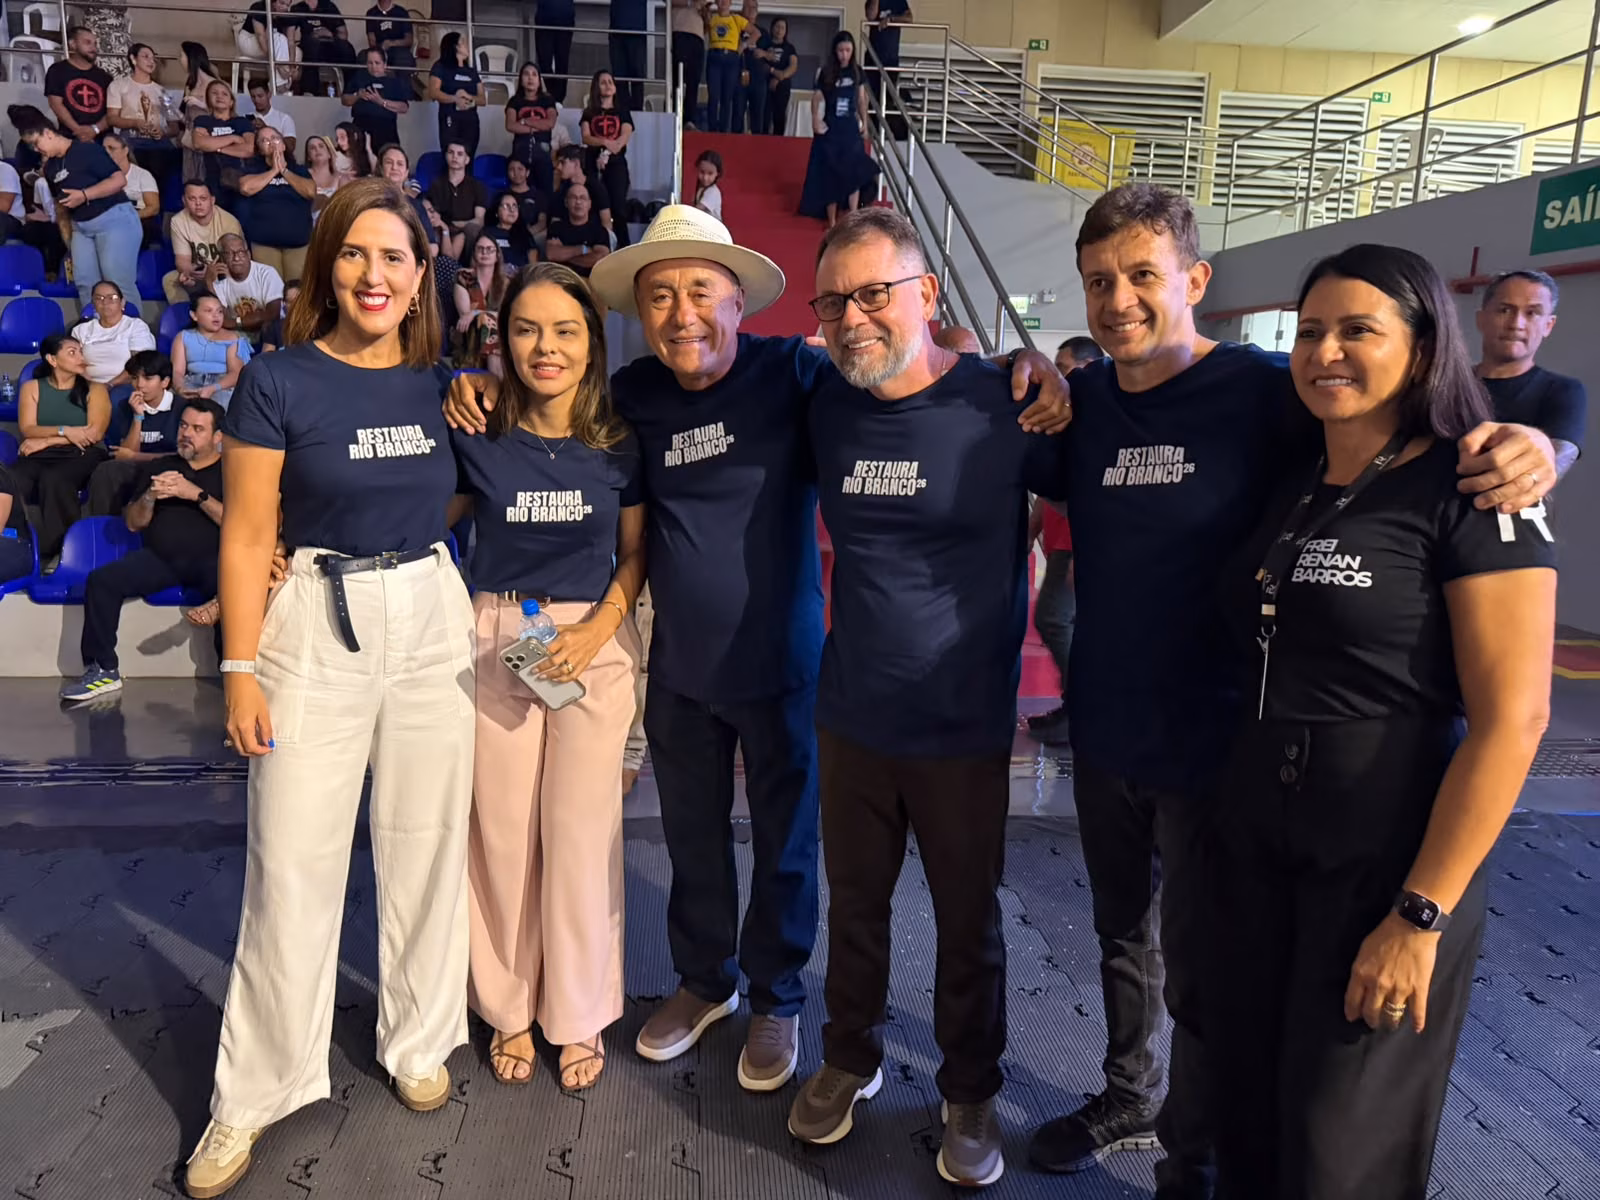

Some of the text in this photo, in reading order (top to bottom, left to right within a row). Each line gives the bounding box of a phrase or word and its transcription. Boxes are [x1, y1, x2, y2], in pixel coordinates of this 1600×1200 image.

[1543, 184, 1600, 229] SAÍ
[357, 424, 425, 444] RESTAURA
[671, 421, 726, 450] RESTAURA
[349, 443, 374, 460] RIO
[664, 449, 682, 467] RIO
[1116, 445, 1185, 467] RESTAURA
[853, 460, 919, 478] RESTAURA
[1102, 467, 1126, 486] RIO
[842, 476, 862, 494] RIO
[516, 490, 583, 507] RESTAURA
[506, 507, 528, 523] RIO
[1302, 538, 1339, 553] FREI
[1296, 552, 1362, 571] RENAN
[1291, 567, 1373, 588] BARROS
